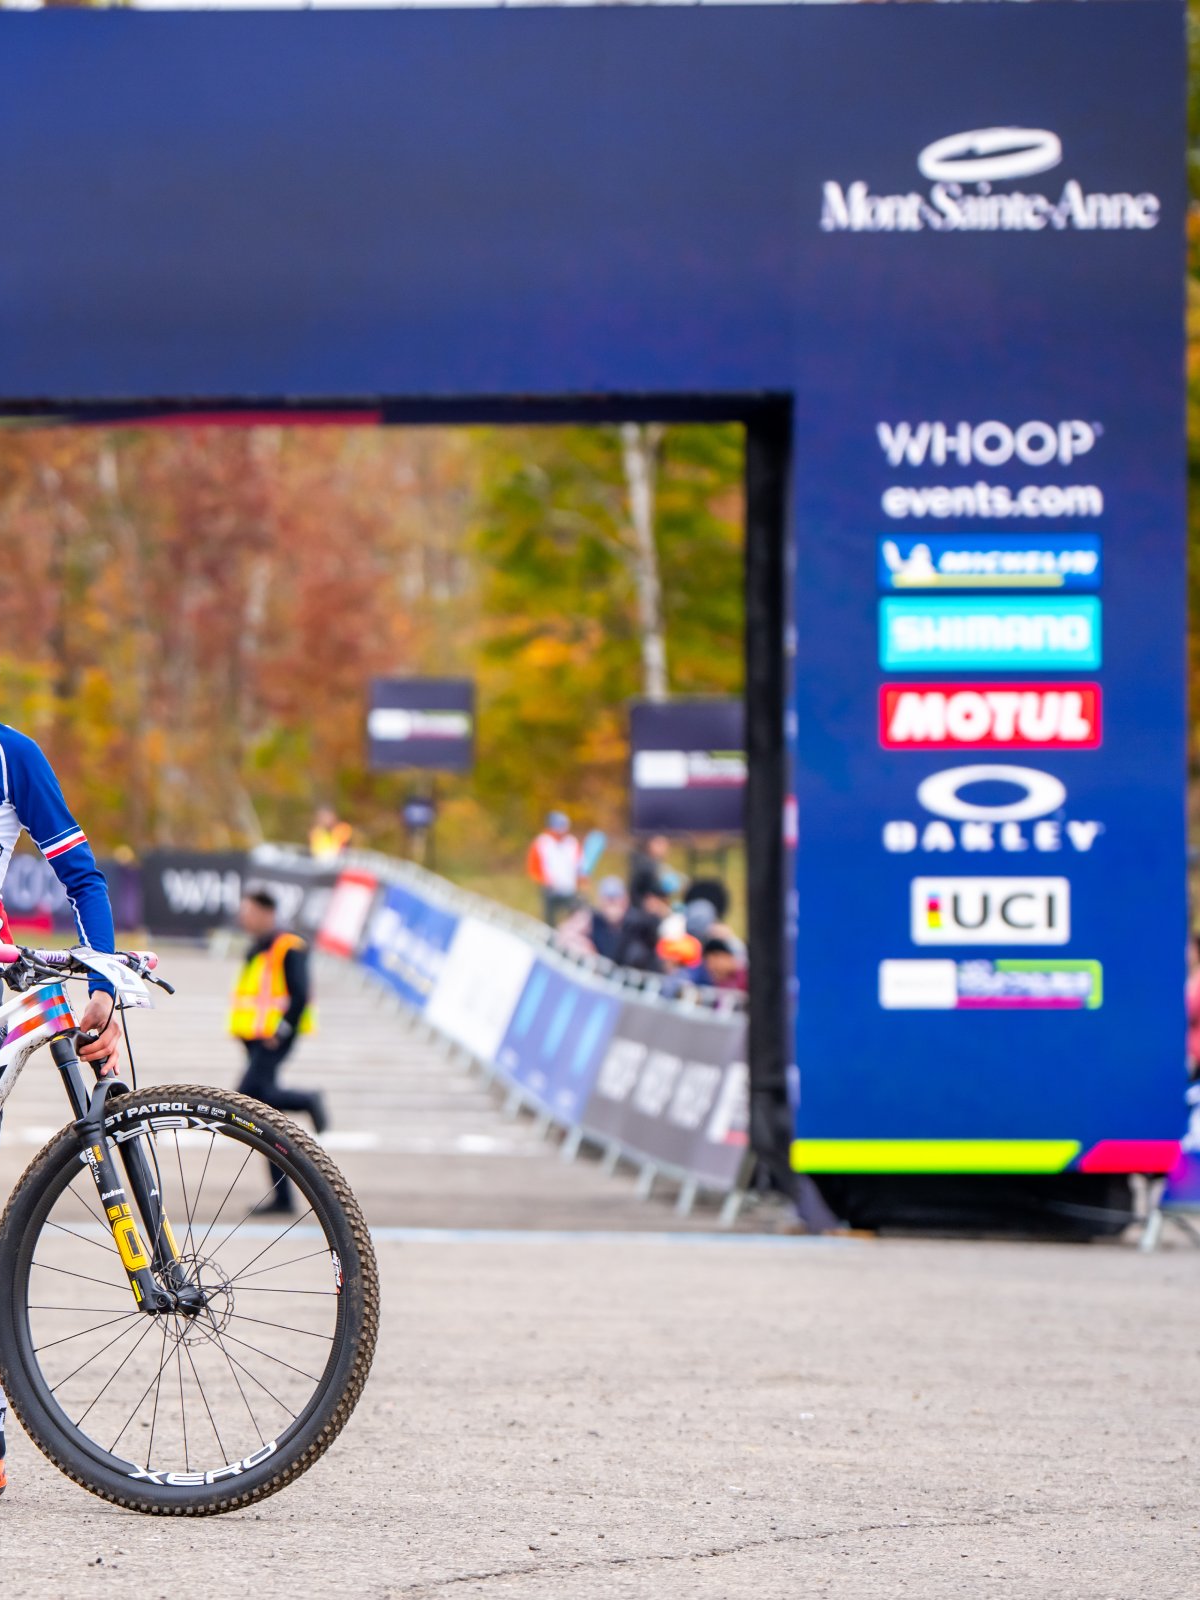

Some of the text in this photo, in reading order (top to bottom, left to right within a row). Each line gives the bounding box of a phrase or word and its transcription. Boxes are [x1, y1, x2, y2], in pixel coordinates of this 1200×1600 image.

[877, 420, 1095, 466] WHOOP
[882, 481, 1103, 518] events.com
[938, 550, 1098, 574] MICHELIN
[890, 615, 1091, 653] SHIMANO
[890, 691, 1091, 742] MOTUL
[883, 821, 1098, 852] OAKLEY
[952, 895, 1056, 929] UCI
[104, 1111, 124, 1128] ST
[127, 1102, 194, 1118] PATROL
[127, 1440, 278, 1487] XERO
